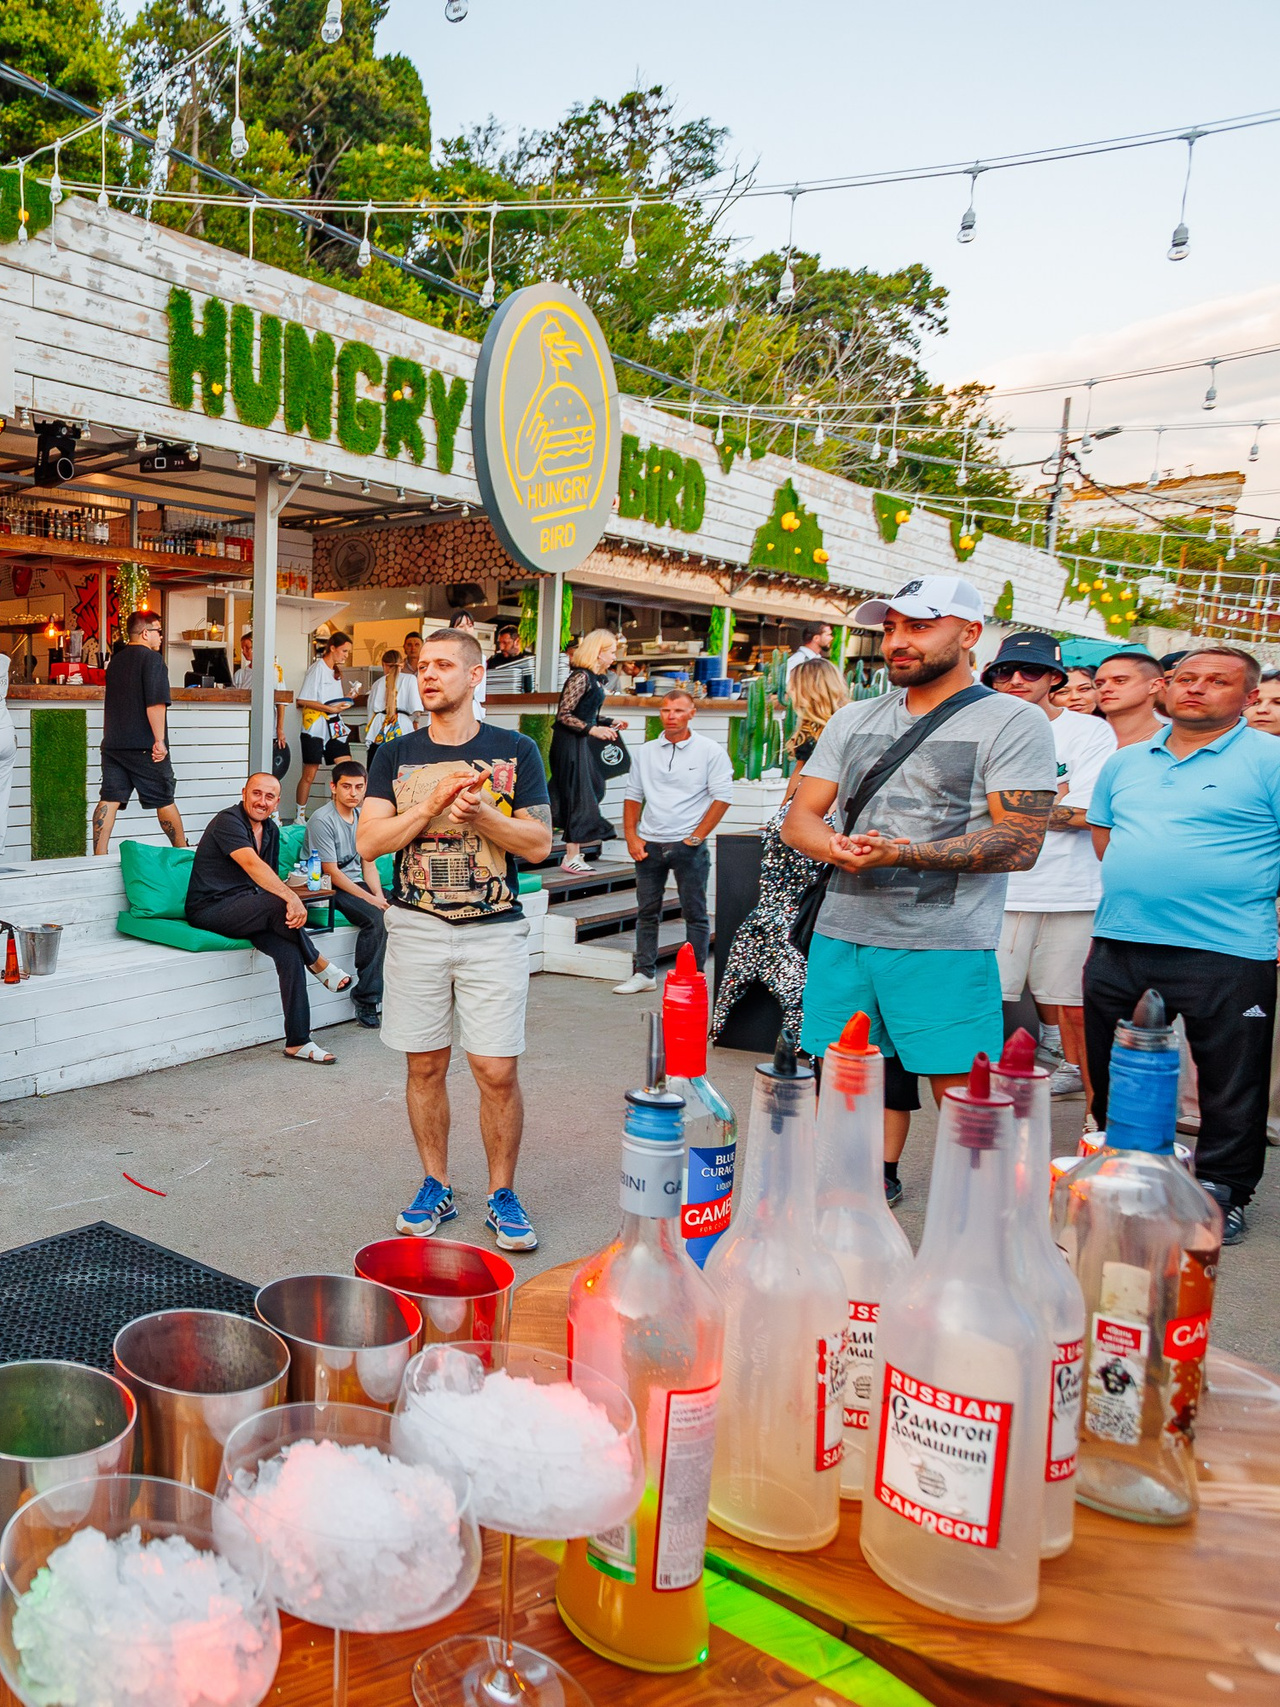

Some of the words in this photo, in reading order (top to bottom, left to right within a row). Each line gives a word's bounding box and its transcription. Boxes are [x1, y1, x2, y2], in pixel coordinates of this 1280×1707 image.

[165, 284, 468, 475] HUNGRY
[618, 432, 706, 534] BIRD
[527, 473, 592, 510] HUNGRY
[540, 522, 576, 553] BIRD
[715, 1151, 735, 1166] BLUE
[684, 1196, 732, 1226] GAMB
[890, 1369, 1002, 1422] RUSSIAN
[892, 1395, 993, 1443] Самогон
[880, 1485, 989, 1545] SAMOGON
